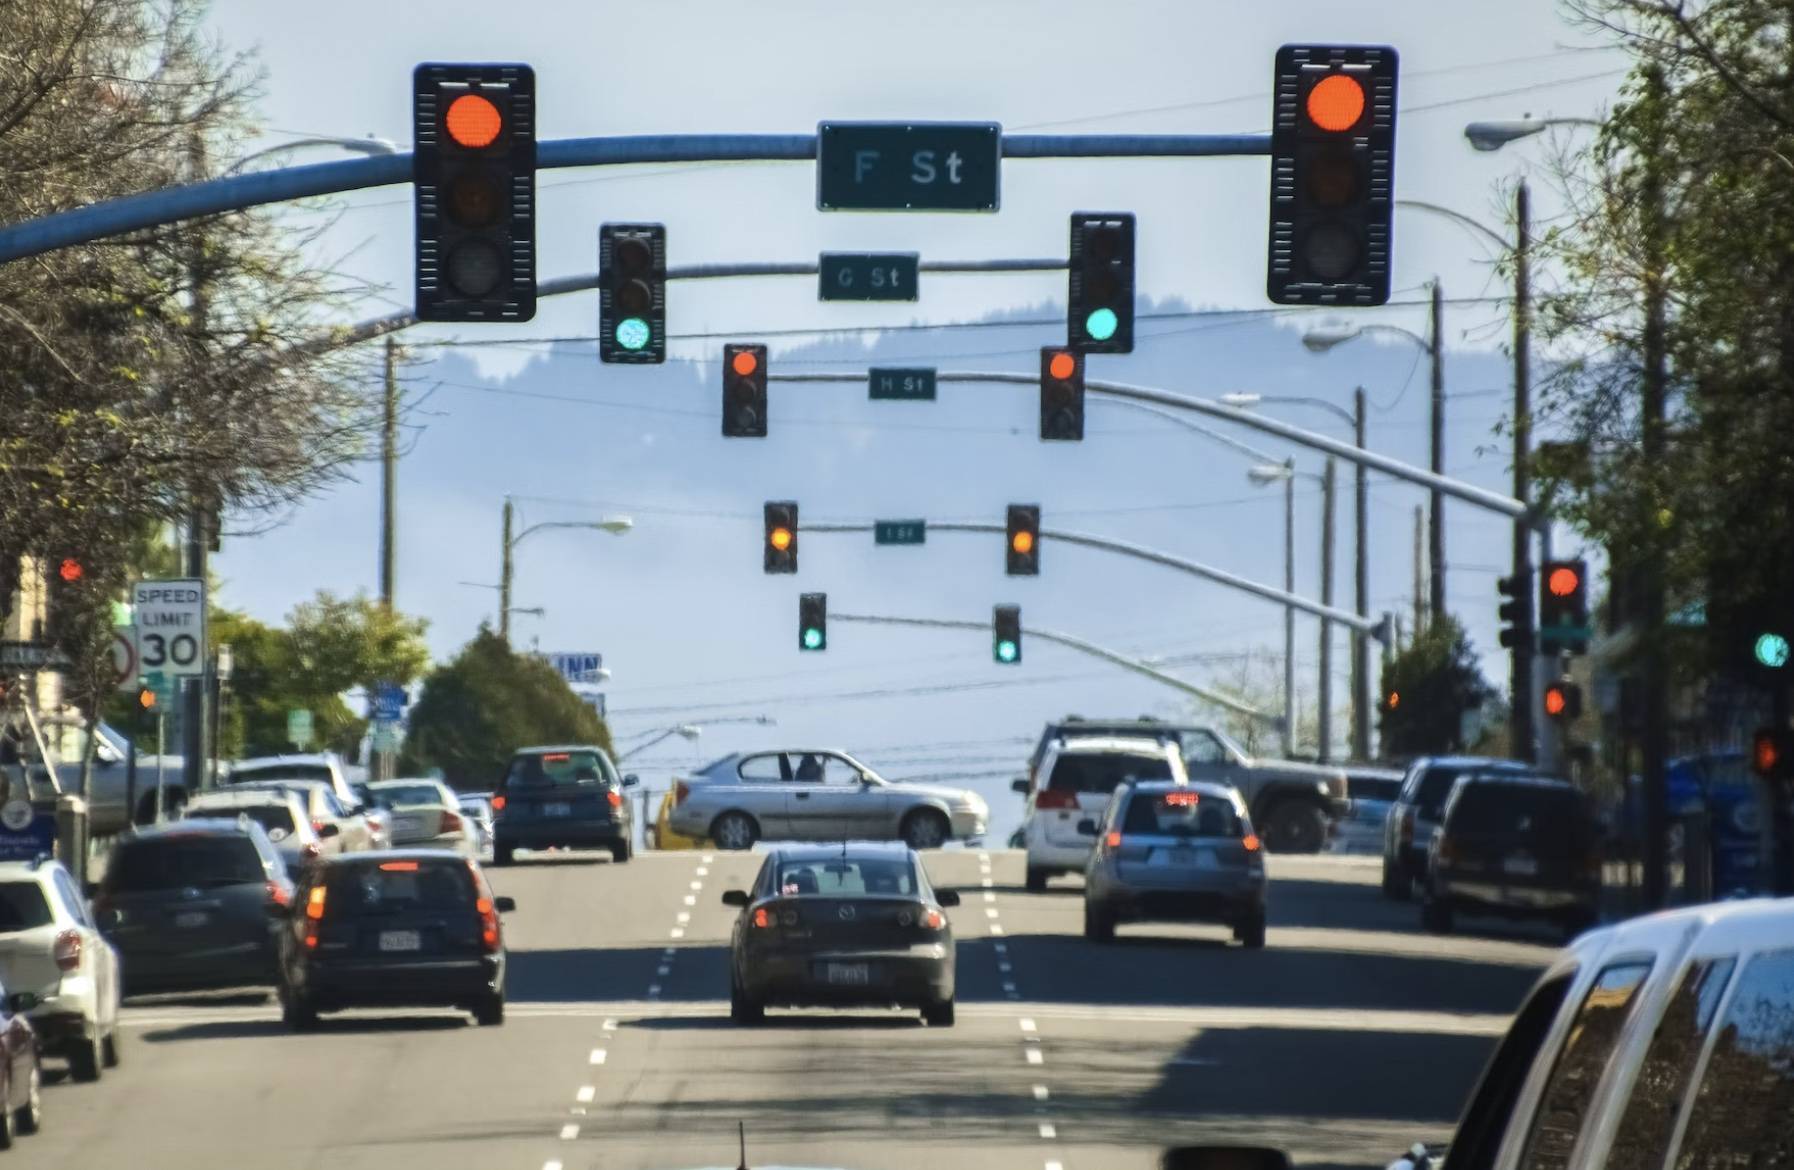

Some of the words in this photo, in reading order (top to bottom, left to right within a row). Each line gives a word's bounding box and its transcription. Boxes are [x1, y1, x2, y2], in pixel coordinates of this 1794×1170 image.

[855, 151, 880, 183] F
[911, 151, 962, 184] St
[838, 268, 853, 286] G
[871, 268, 899, 287] St
[881, 376, 893, 391] H
[903, 376, 924, 392] St
[137, 589, 199, 603] SPEED
[142, 612, 193, 626] LIMIT
[143, 633, 198, 667] 30
